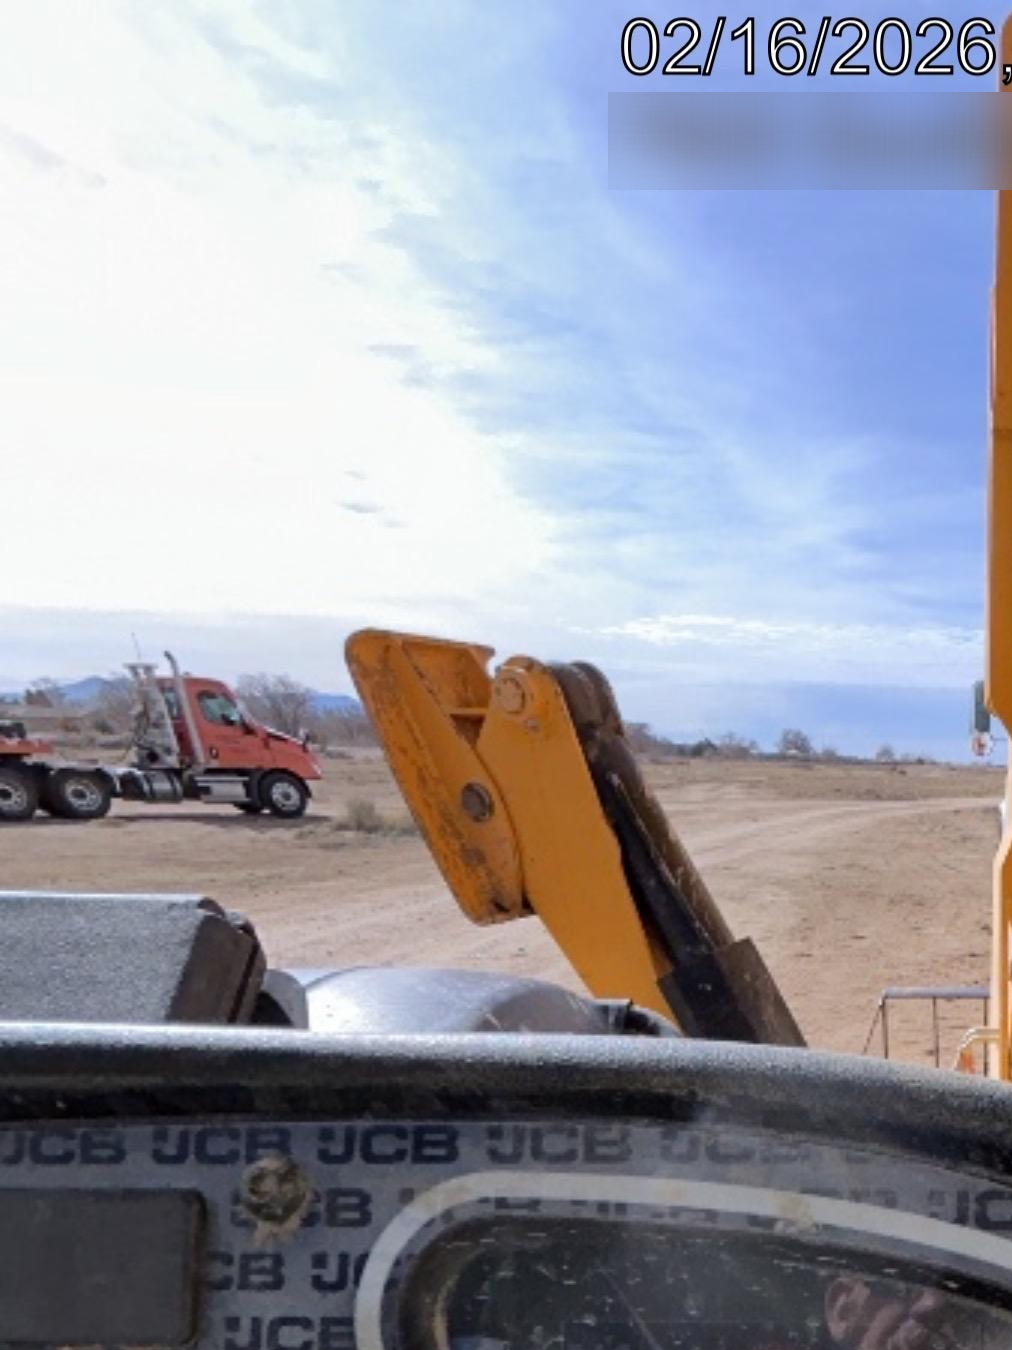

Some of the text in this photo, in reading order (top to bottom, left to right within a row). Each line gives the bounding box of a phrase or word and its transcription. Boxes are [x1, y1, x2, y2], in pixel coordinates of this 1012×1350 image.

[152, 1126, 292, 1165] JCB
[317, 1125, 459, 1164] JCB
[487, 1125, 632, 1164] JCB
[206, 1251, 286, 1291] CB
